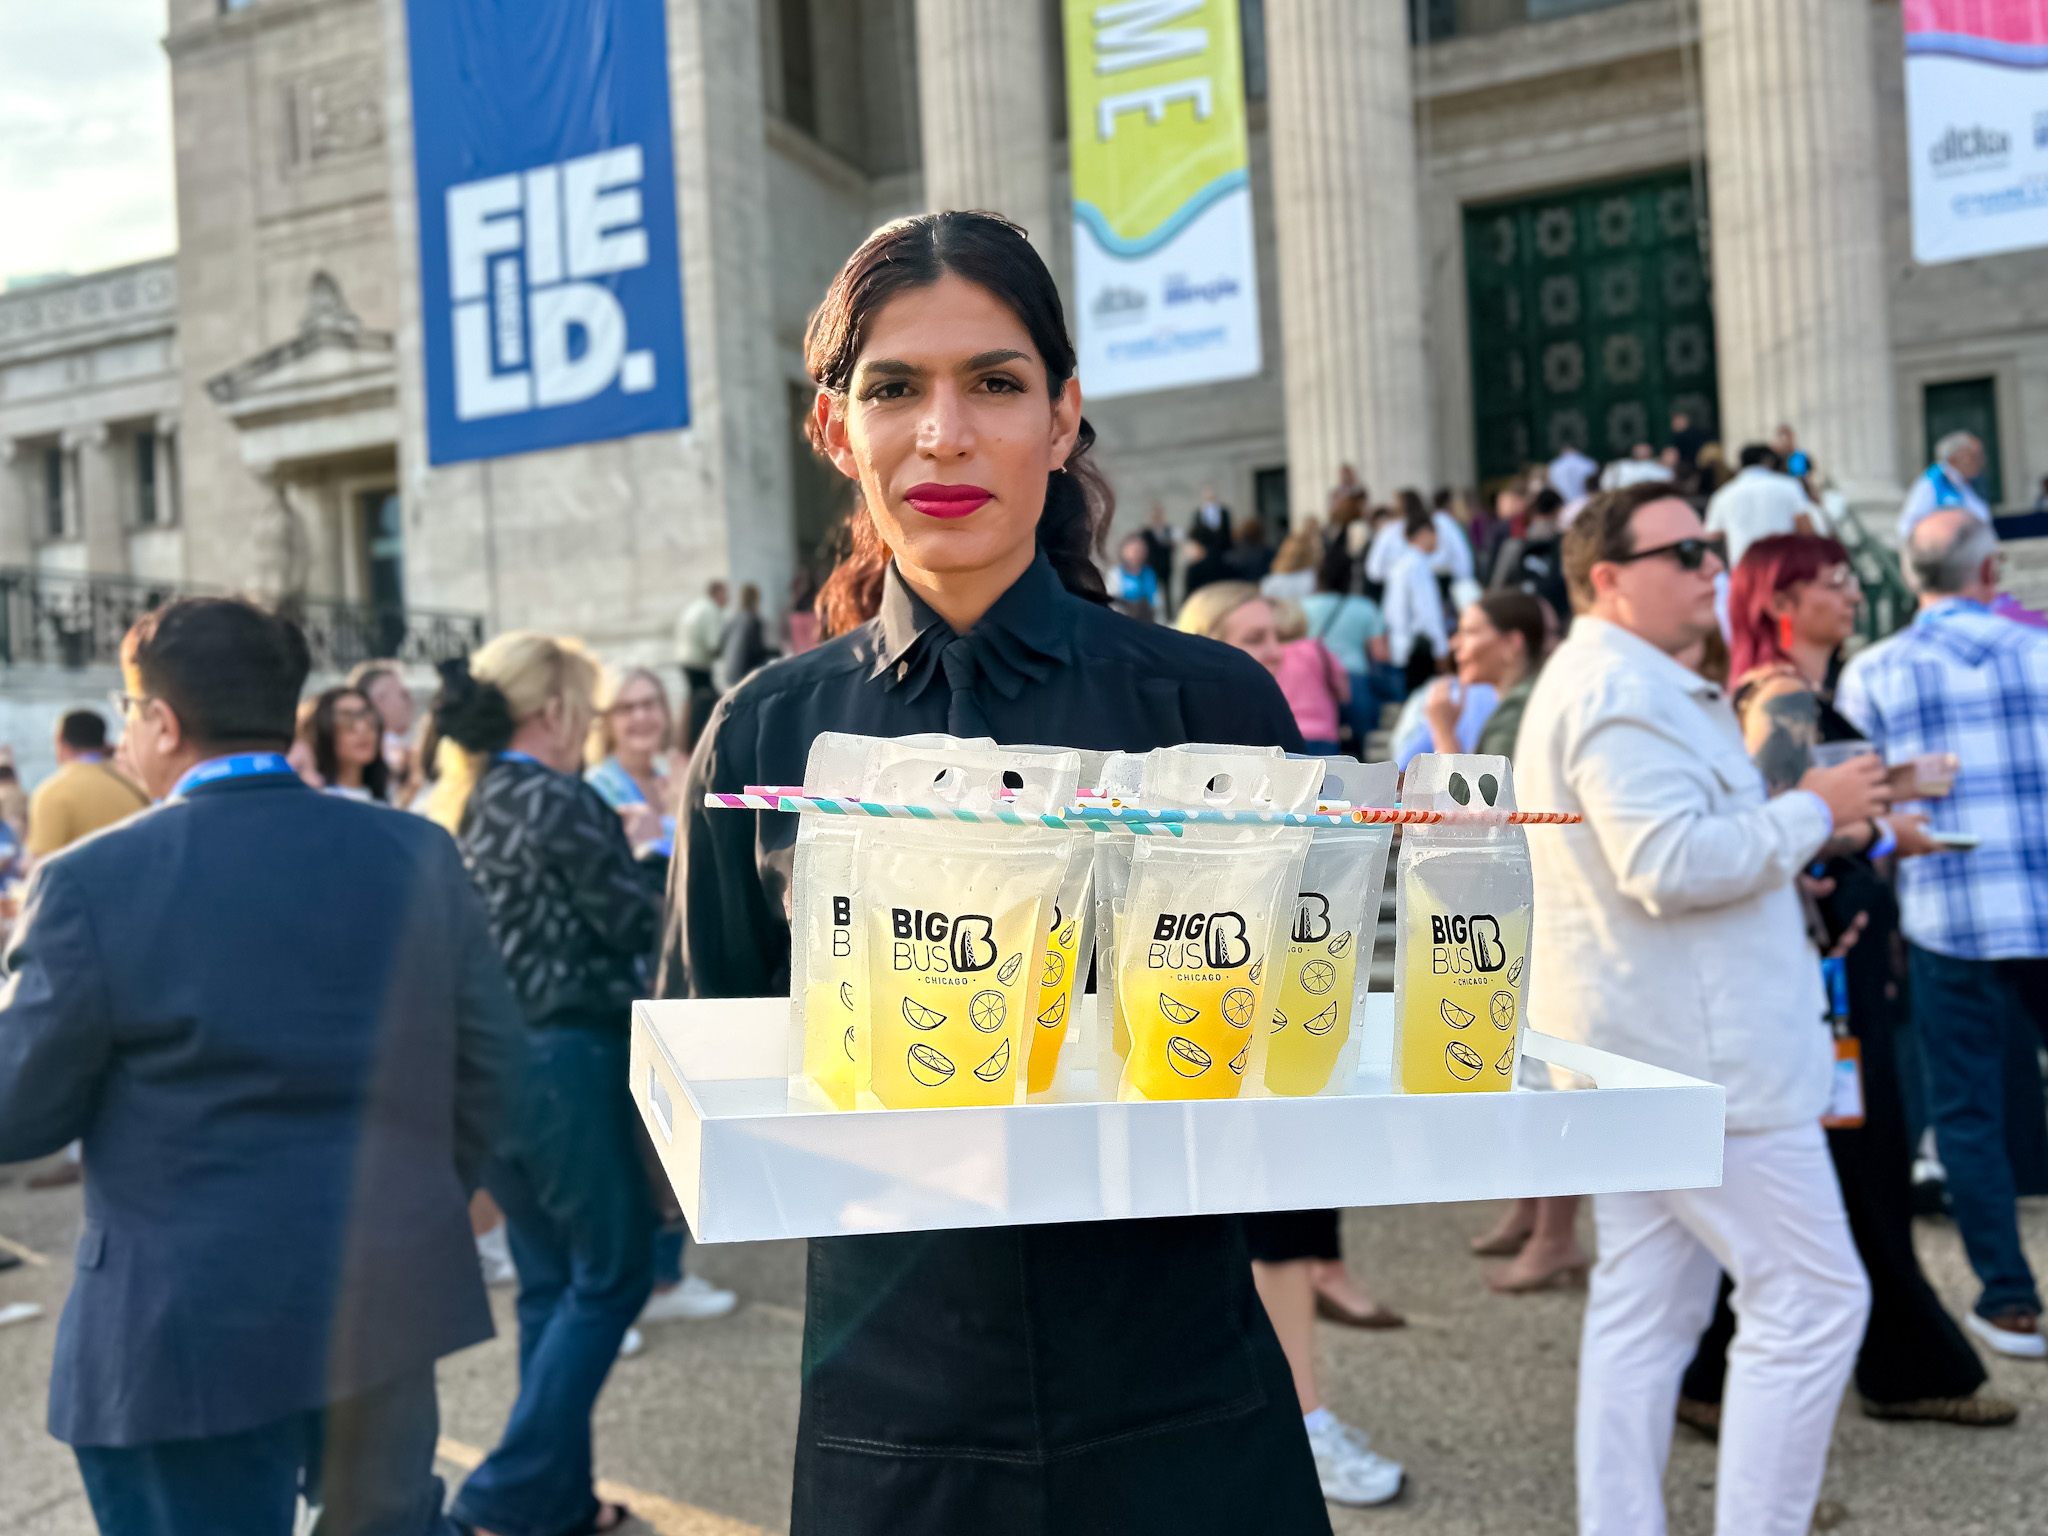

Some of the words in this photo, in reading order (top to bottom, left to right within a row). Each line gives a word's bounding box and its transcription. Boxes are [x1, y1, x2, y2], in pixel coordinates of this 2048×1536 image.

[892, 908, 949, 943] BIG
[1153, 913, 1206, 942] BIG
[1431, 914, 1468, 945] BIG
[893, 941, 949, 973] BUS
[1148, 942, 1203, 970] BUS
[1432, 947, 1473, 975] BUS
[925, 976, 968, 985] CHICAGO
[1177, 973, 1222, 982] CHICAGO
[1458, 977, 1488, 986] CHICAGO
